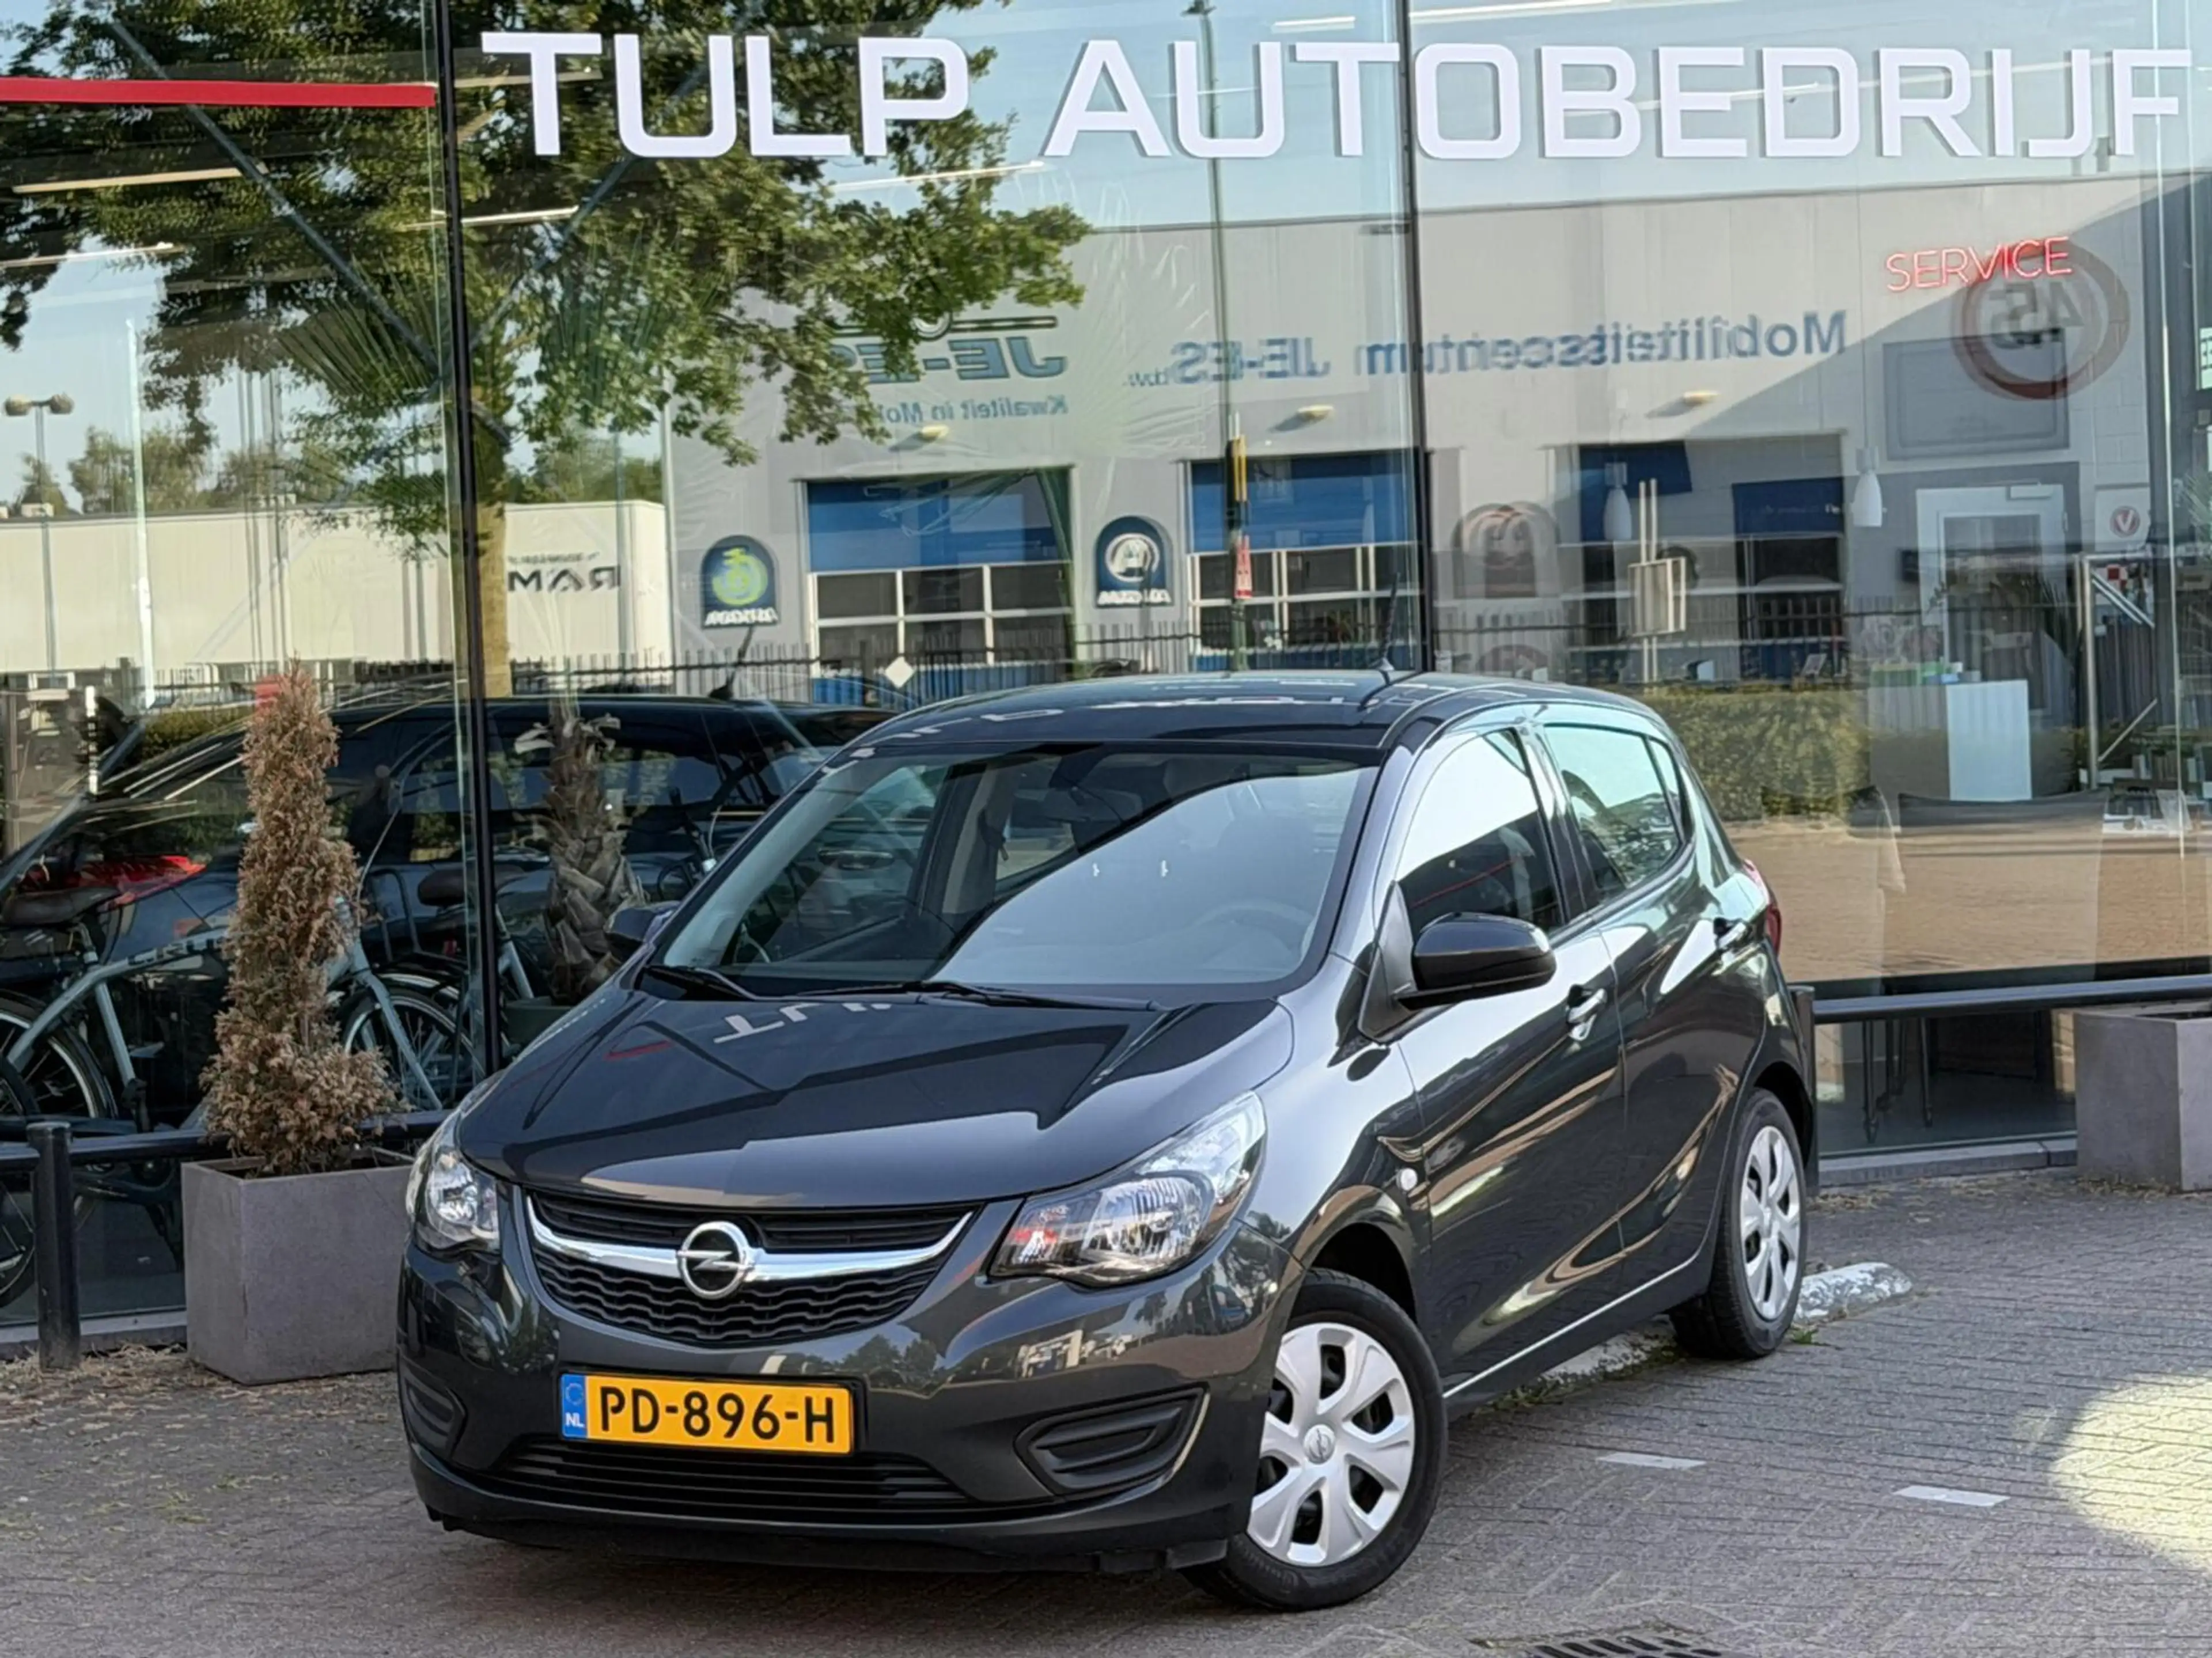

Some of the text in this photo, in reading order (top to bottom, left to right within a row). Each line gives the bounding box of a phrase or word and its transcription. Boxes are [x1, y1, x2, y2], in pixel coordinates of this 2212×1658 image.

[481, 31, 2192, 160] TULP AUTOBEDRIJF
[1885, 236, 2074, 292] SERVICE
[565, 1412, 585, 1428] NL
[600, 1386, 835, 1443] PD-896-H
